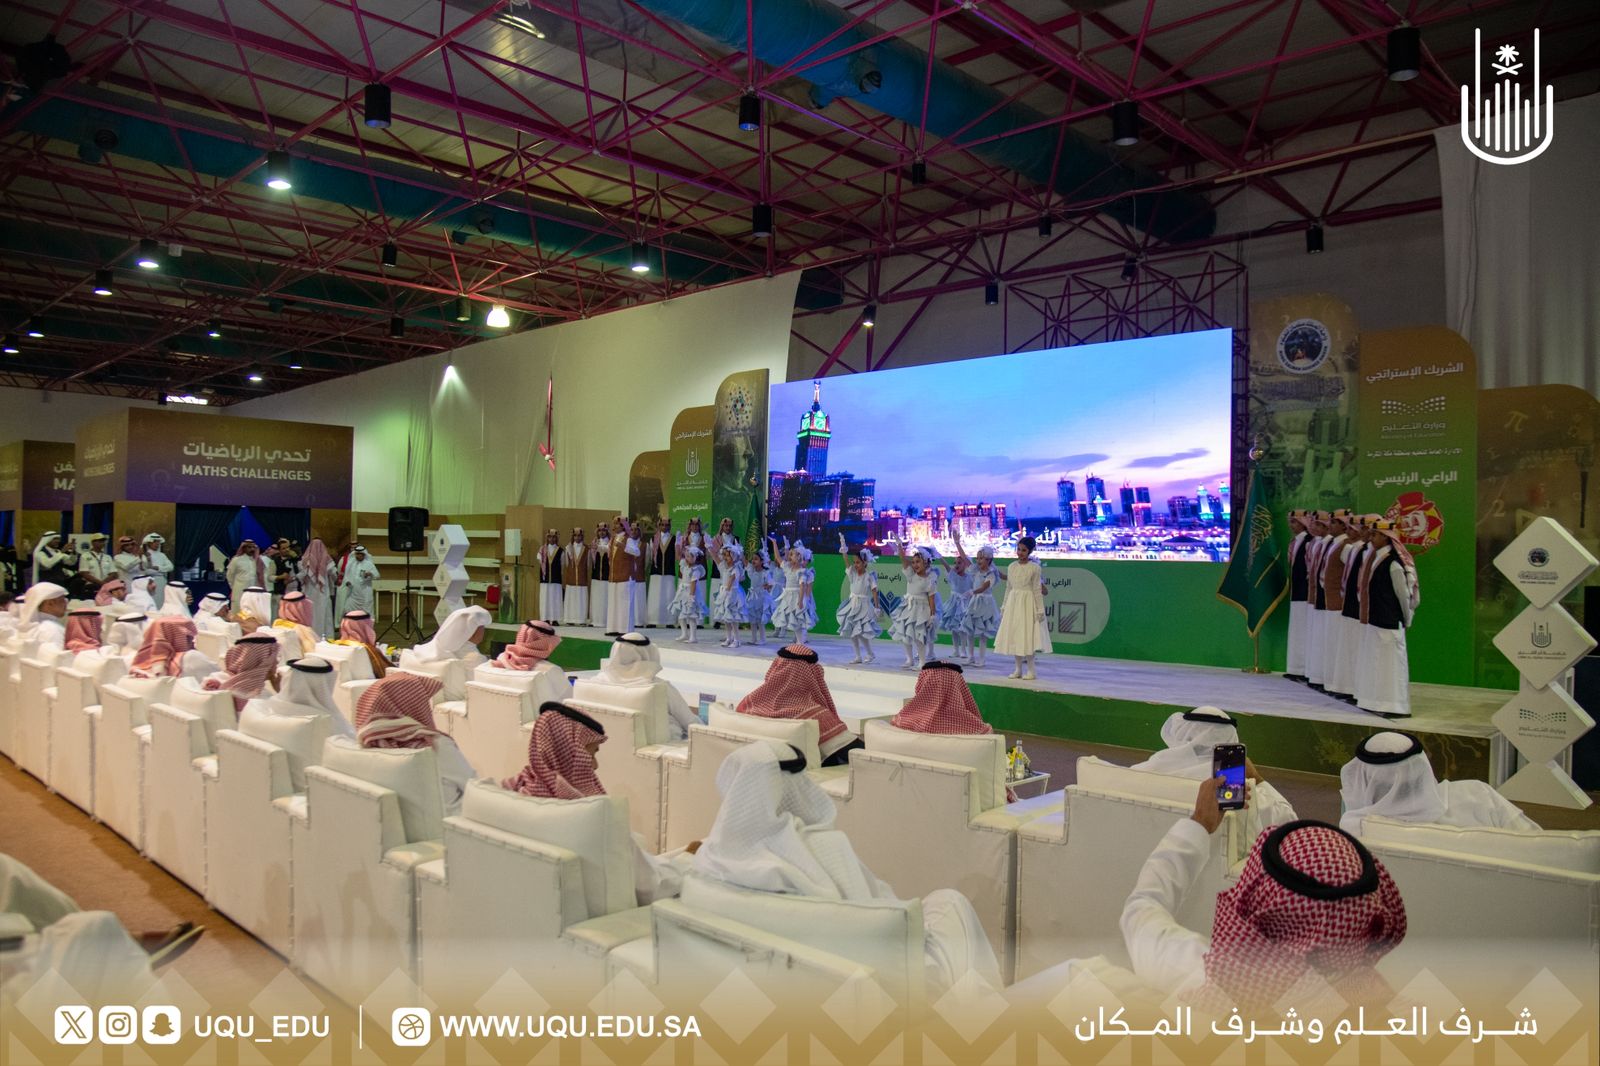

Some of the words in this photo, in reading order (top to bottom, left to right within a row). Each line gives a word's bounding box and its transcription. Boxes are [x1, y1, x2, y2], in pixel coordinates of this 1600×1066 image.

[1424, 361, 1464, 377] الشريك
[183, 442, 260, 462] الرياضيات
[264, 449, 312, 463] تحدي
[182, 464, 228, 477] MATHS
[230, 467, 312, 481] CHALLENGES
[1374, 471, 1419, 488] الرئيسي
[1421, 470, 1458, 487] الراعي
[1051, 578, 1072, 589] الراعي
